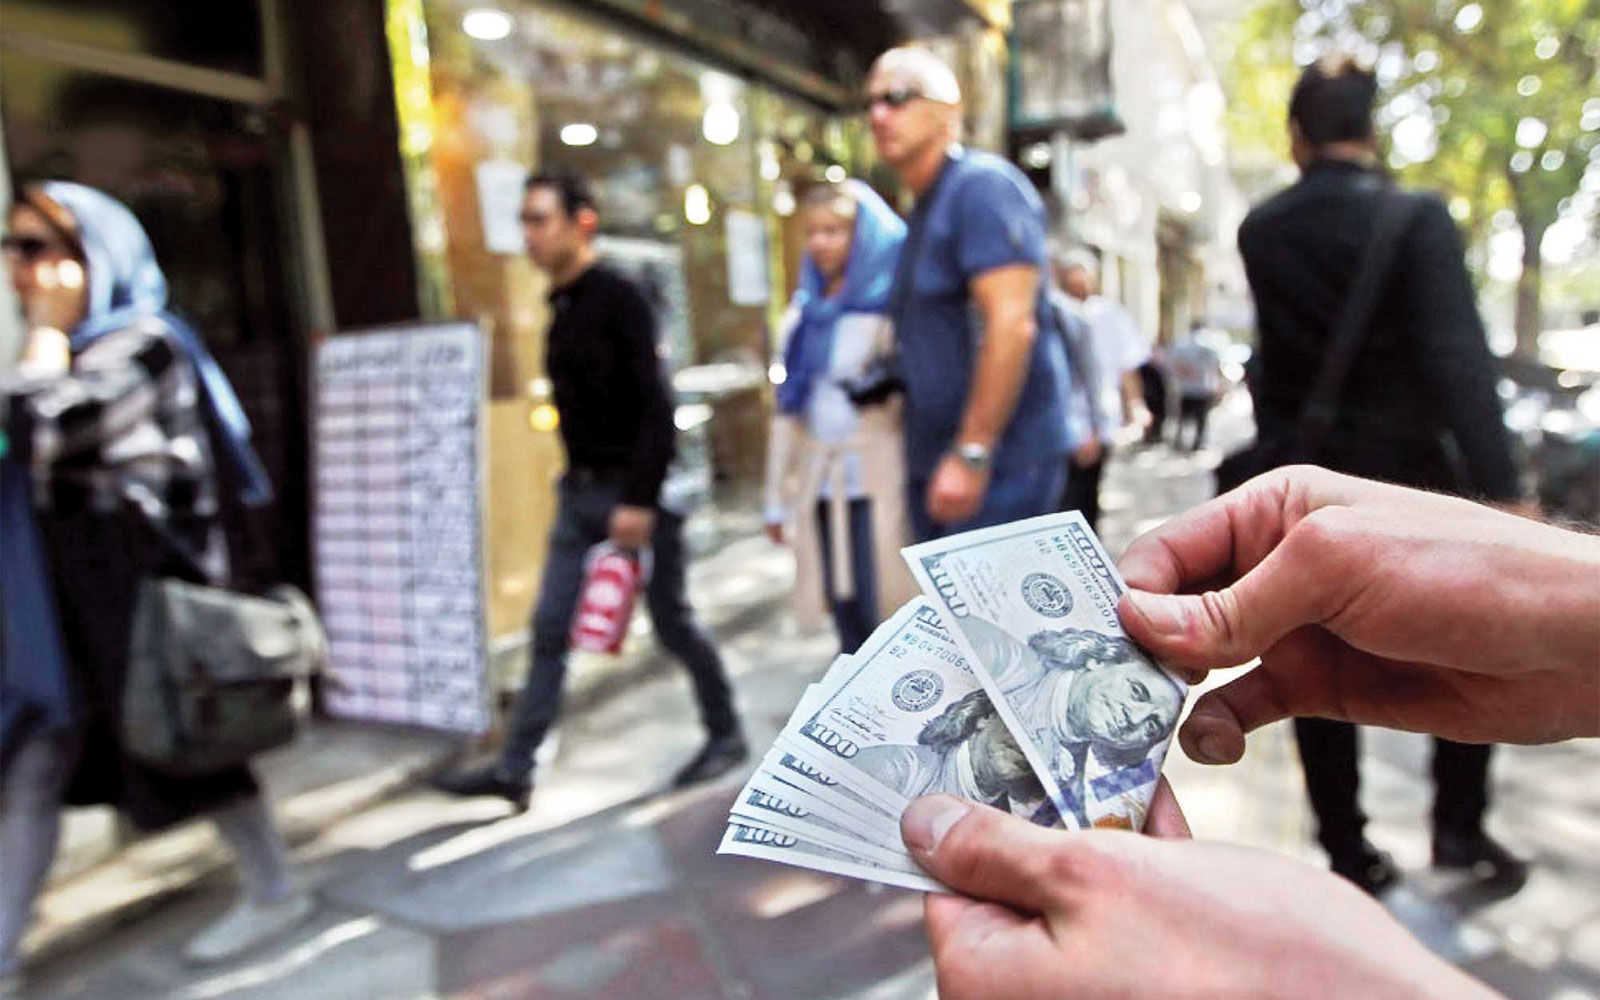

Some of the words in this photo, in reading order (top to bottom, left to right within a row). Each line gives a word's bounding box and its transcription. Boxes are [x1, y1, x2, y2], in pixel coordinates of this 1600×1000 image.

[1073, 528, 1109, 579] 100
[929, 561, 970, 619] 100
[812, 723, 860, 759] 100
